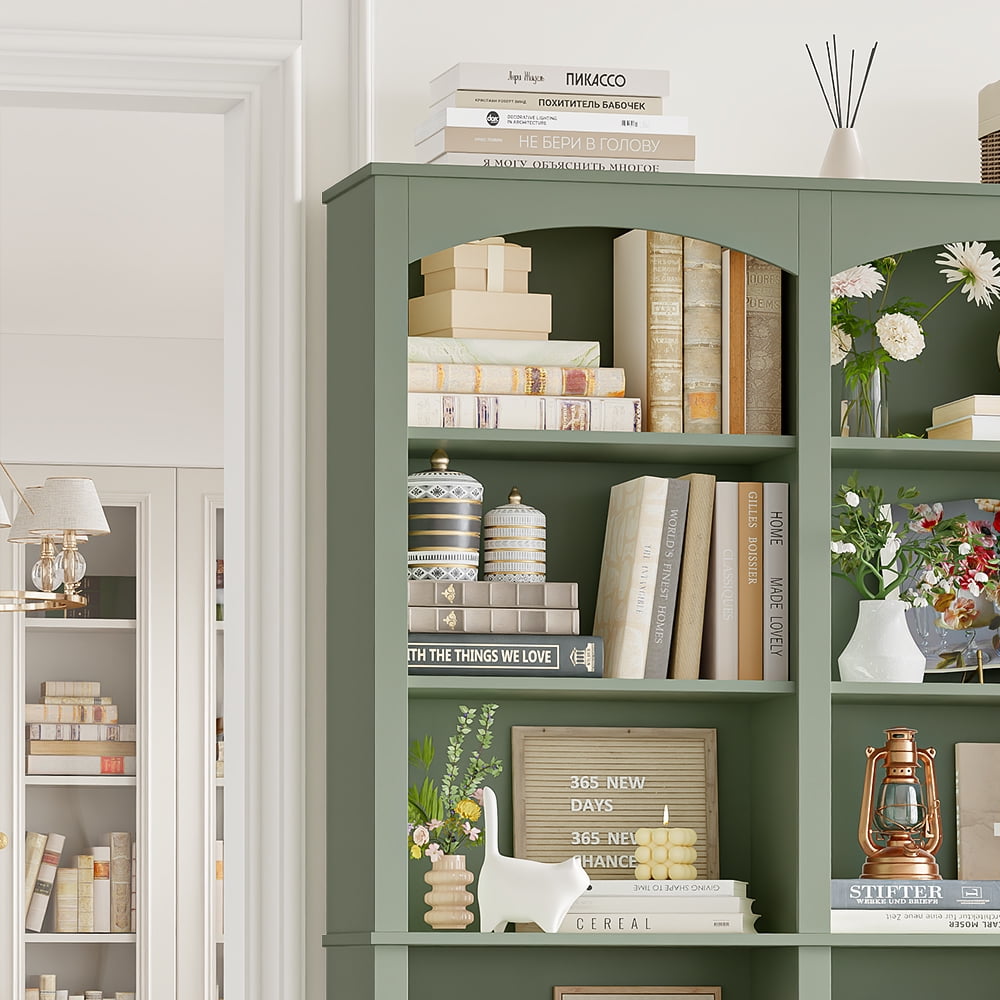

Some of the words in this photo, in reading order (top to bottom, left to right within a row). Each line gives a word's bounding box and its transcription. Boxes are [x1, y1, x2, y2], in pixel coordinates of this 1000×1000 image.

[566, 72, 627, 88] ПИКАССО
[538, 98, 601, 110] ПОХИТИТЕЛЬ
[602, 100, 646, 111] БАБОЧЕК
[519, 134, 538, 149] НЕ
[542, 135, 582, 150] БЕРИ
[587, 136, 597, 150] В
[600, 137, 661, 153] ГОЛОВУ
[483, 158, 490, 168] Я
[532, 160, 605, 172] ОБЪЯСНИТЬ
[748, 491, 758, 529] GILLES
[665, 508, 679, 558] WORLD'S
[770, 511, 783, 546] HOME
[748, 536, 758, 585] BOISSIER
[661, 561, 674, 600] FINEST
[722, 548, 735, 623] CLASSIQUES
[770, 577, 783, 610] MADE
[655, 605, 668, 645] HOMES
[770, 616, 783, 657] LOVELY
[408, 649, 426, 662] ITH
[428, 648, 451, 662] THE
[455, 649, 498, 663] THINGS
[501, 650, 520, 662] WE
[522, 650, 552, 663] LOVE
[569, 775, 599, 790] 365
[606, 776, 646, 790] NEW
[570, 798, 613, 812] DAYS
[571, 831, 600, 845] 365
[633, 883, 651, 892] TIME
[652, 883, 663, 892] TO
[664, 883, 689, 892] SHAPE
[690, 883, 720, 892] GIVING
[850, 884, 944, 899] STIFTER
[886, 912, 902, 920] Zeit
[576, 917, 652, 931] CEREAL
[949, 920, 979, 928] MOSER
